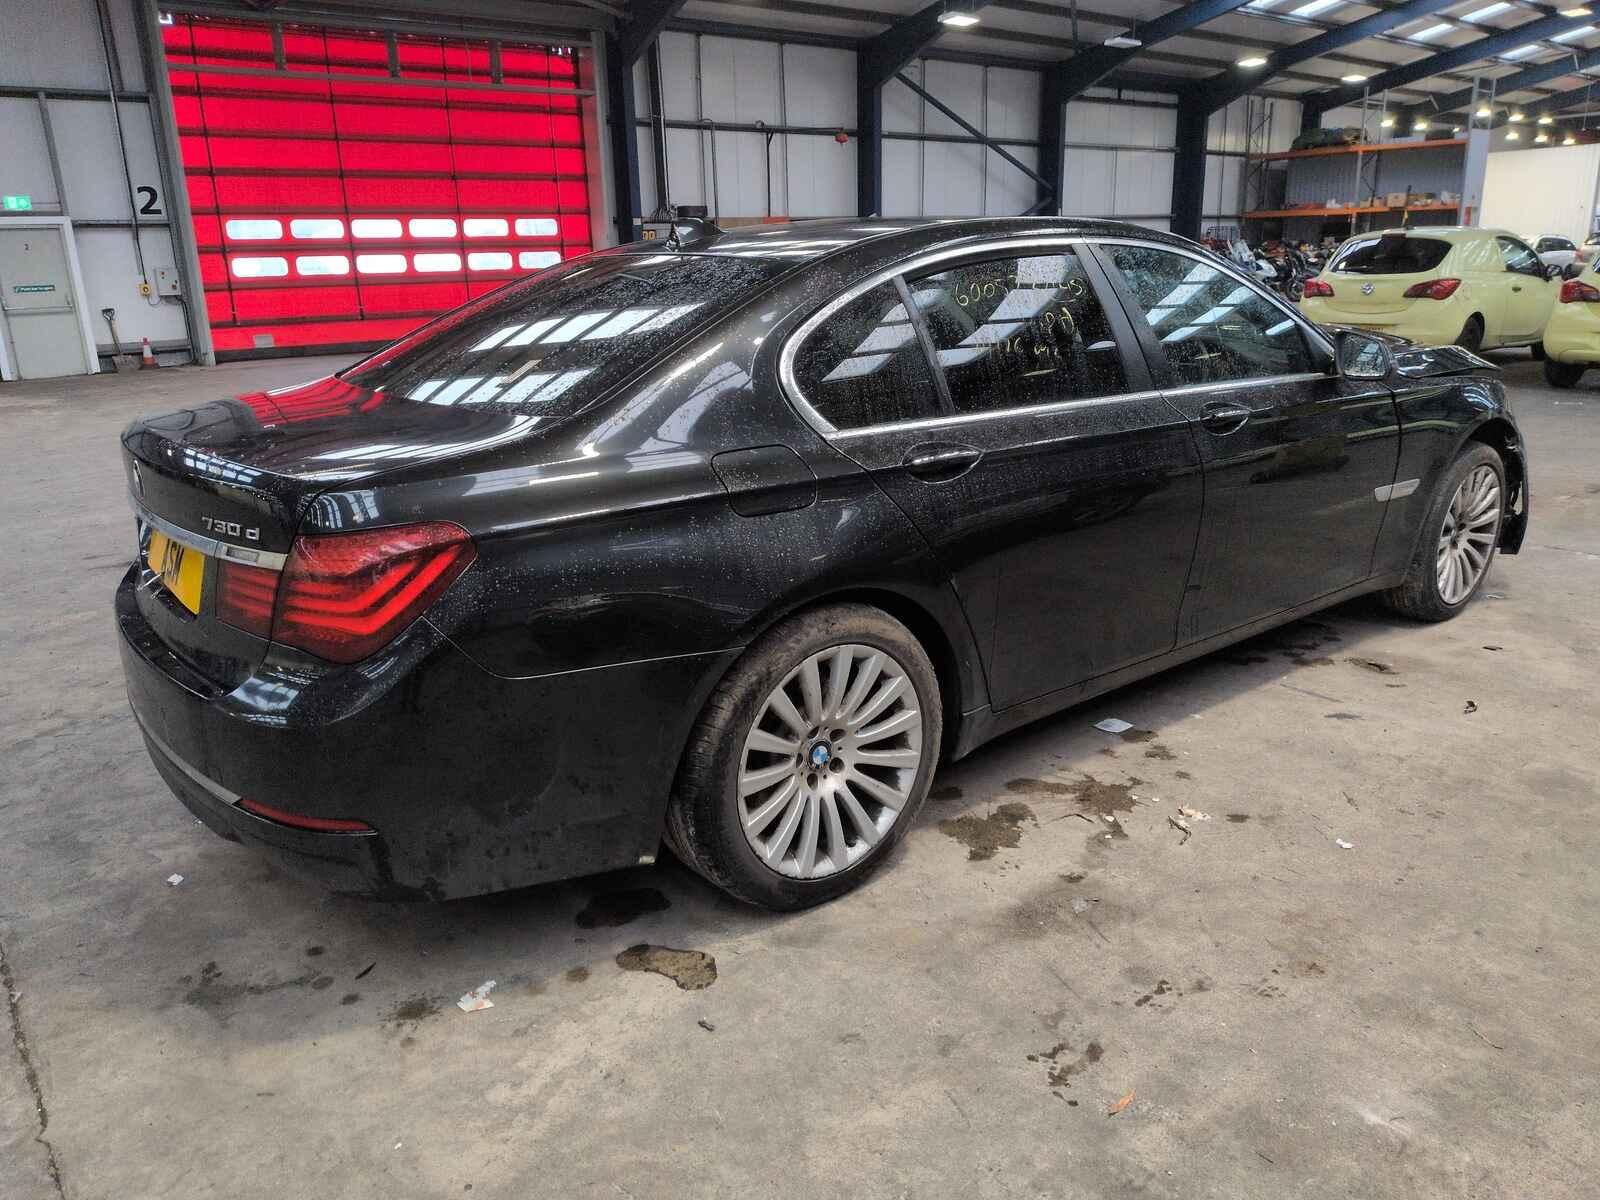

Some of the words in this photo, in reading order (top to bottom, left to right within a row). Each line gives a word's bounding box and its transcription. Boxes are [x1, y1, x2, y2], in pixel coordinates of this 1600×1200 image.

[137, 186, 162, 214] 2
[202, 517, 241, 536] 730
[245, 527, 260, 541] d
